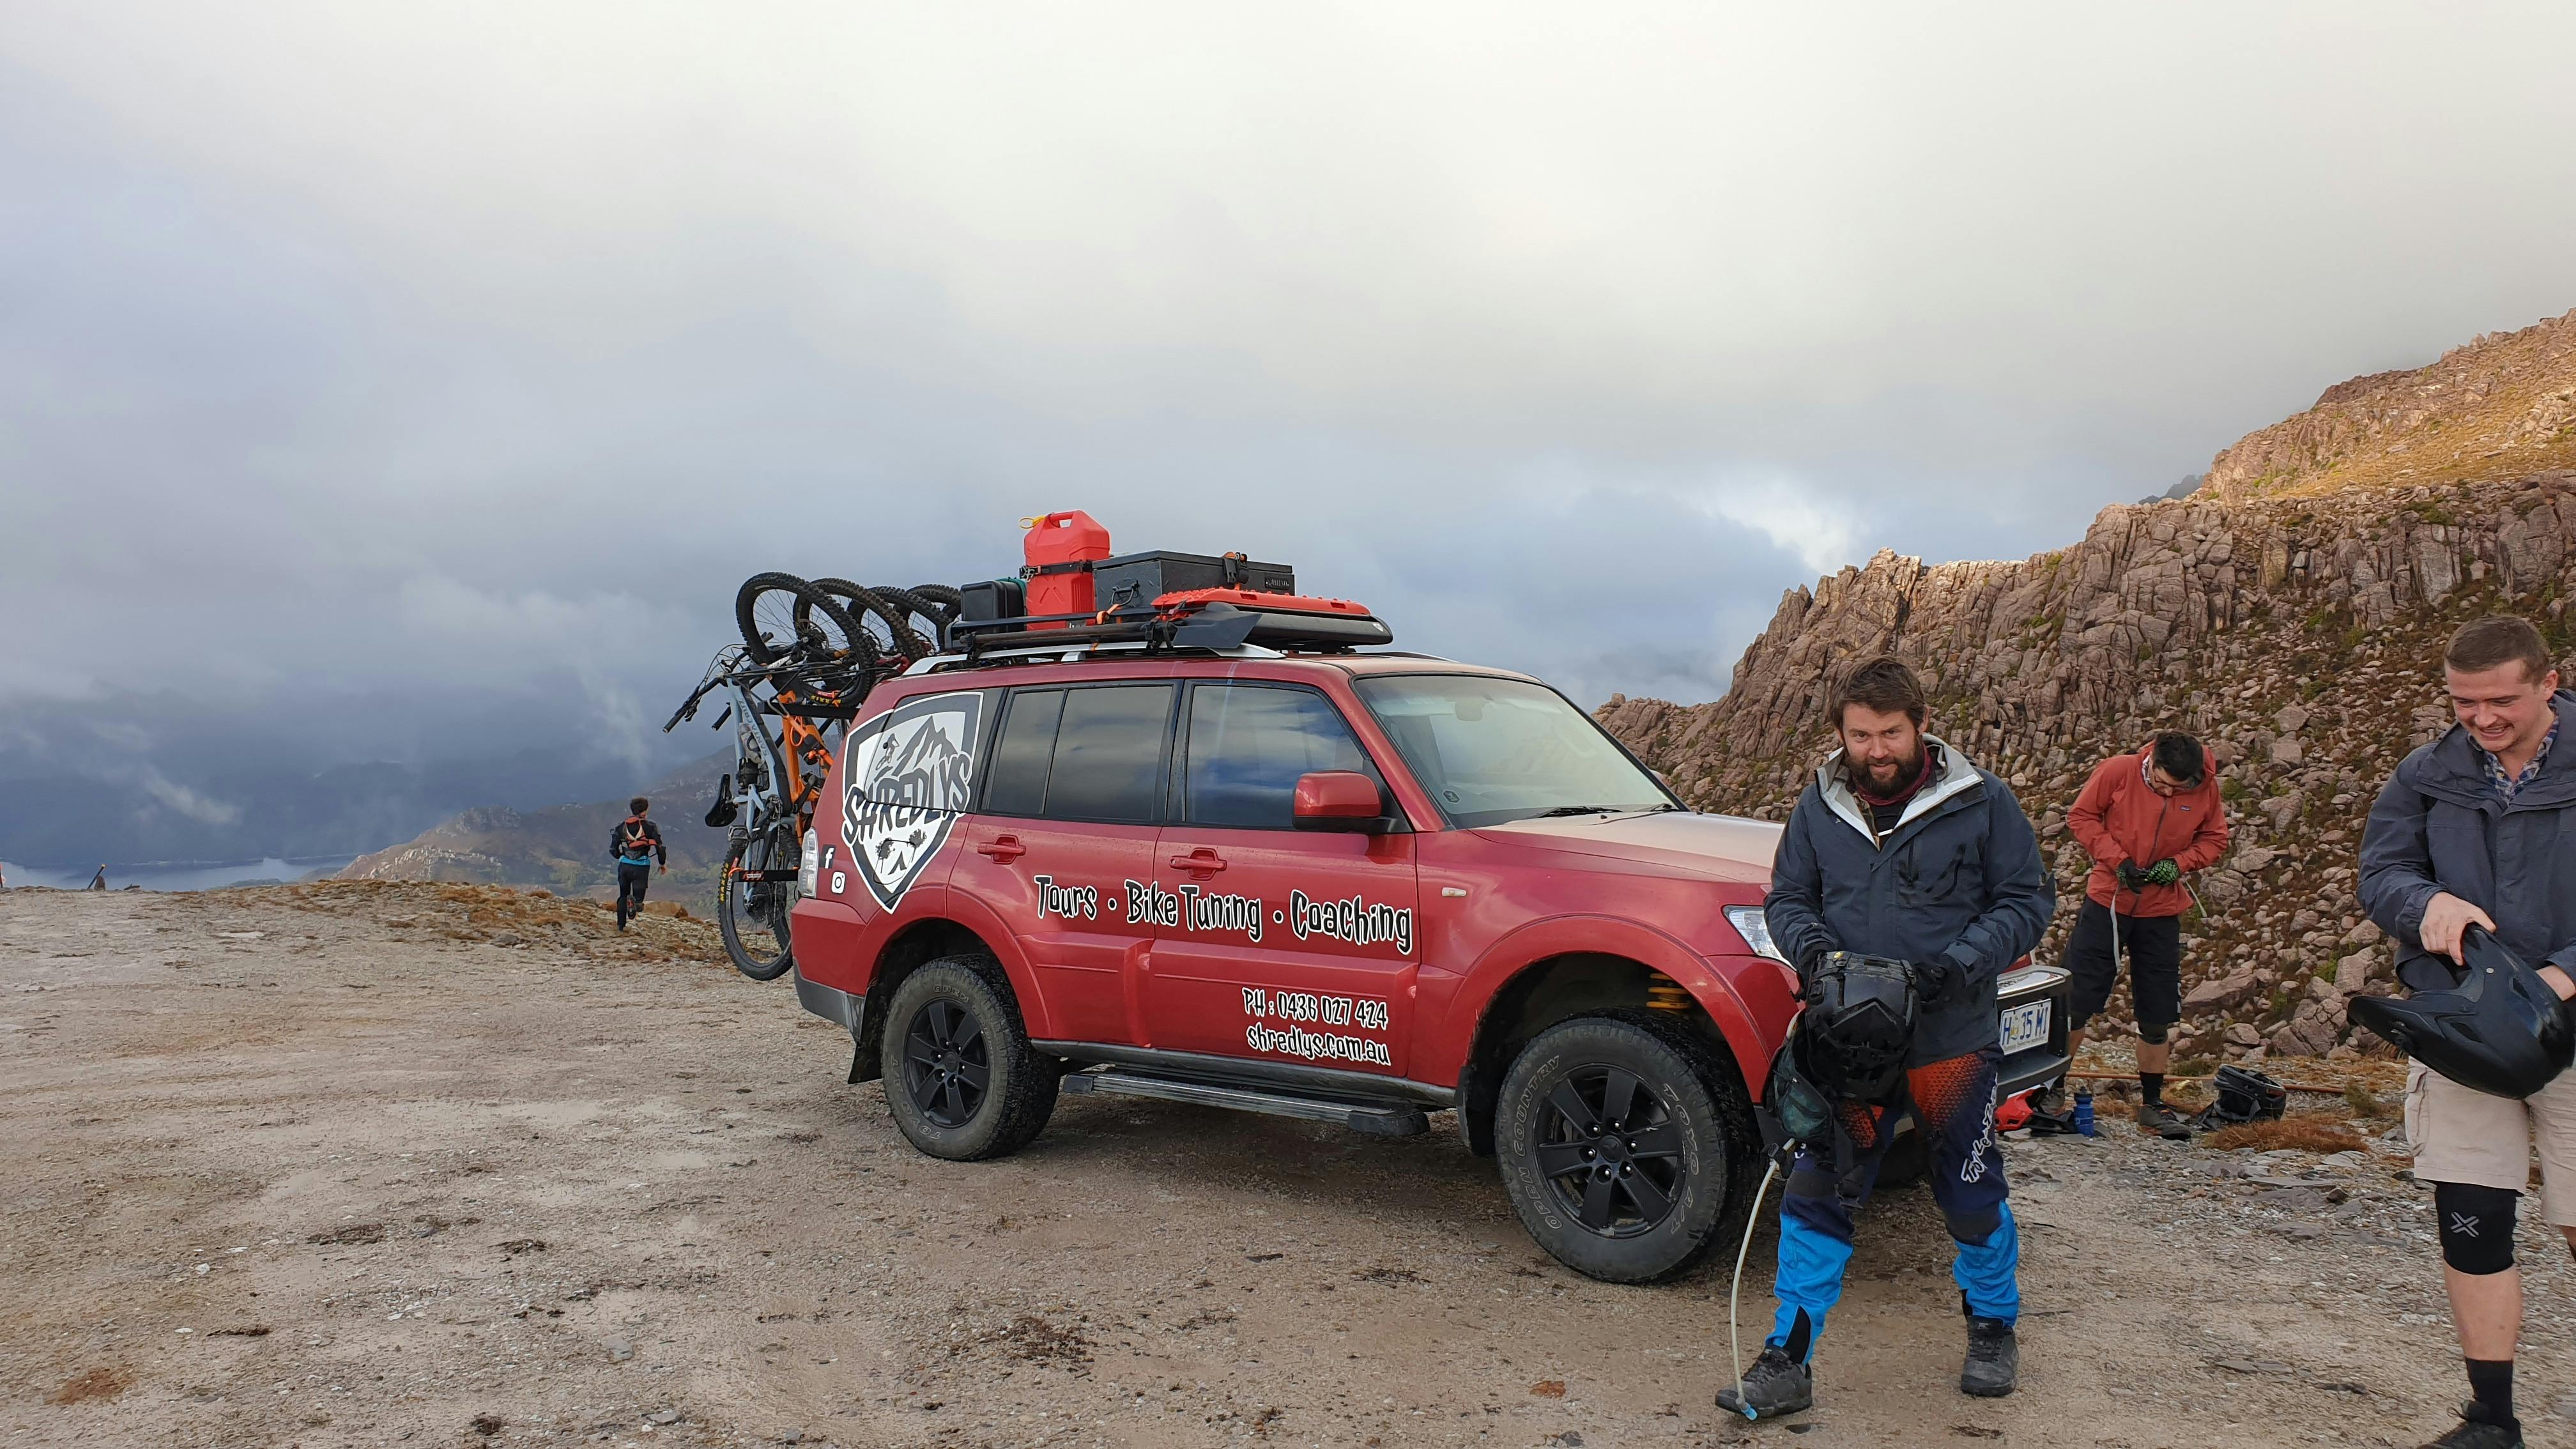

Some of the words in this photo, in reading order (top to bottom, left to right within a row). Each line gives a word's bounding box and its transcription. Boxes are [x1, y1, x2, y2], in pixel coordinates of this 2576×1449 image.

[843, 752, 970, 846] SHREDLYS
[1034, 875, 1097, 920] Tours
[1124, 879, 1178, 926] Bike
[1179, 884, 1262, 942] Tuning
[1289, 889, 1413, 955] Coaching
[1242, 987, 1265, 1017] PH
[1276, 991, 1318, 1022] 0436
[1321, 995, 1352, 1025] 027
[1354, 999, 1388, 1031] 424
[1246, 1022, 1391, 1066] shredlys.com.au
[1514, 1055, 1560, 1157] COUNTRY
[1663, 1083, 1699, 1176] TOYO
[1518, 1167, 1563, 1229] OPEN
